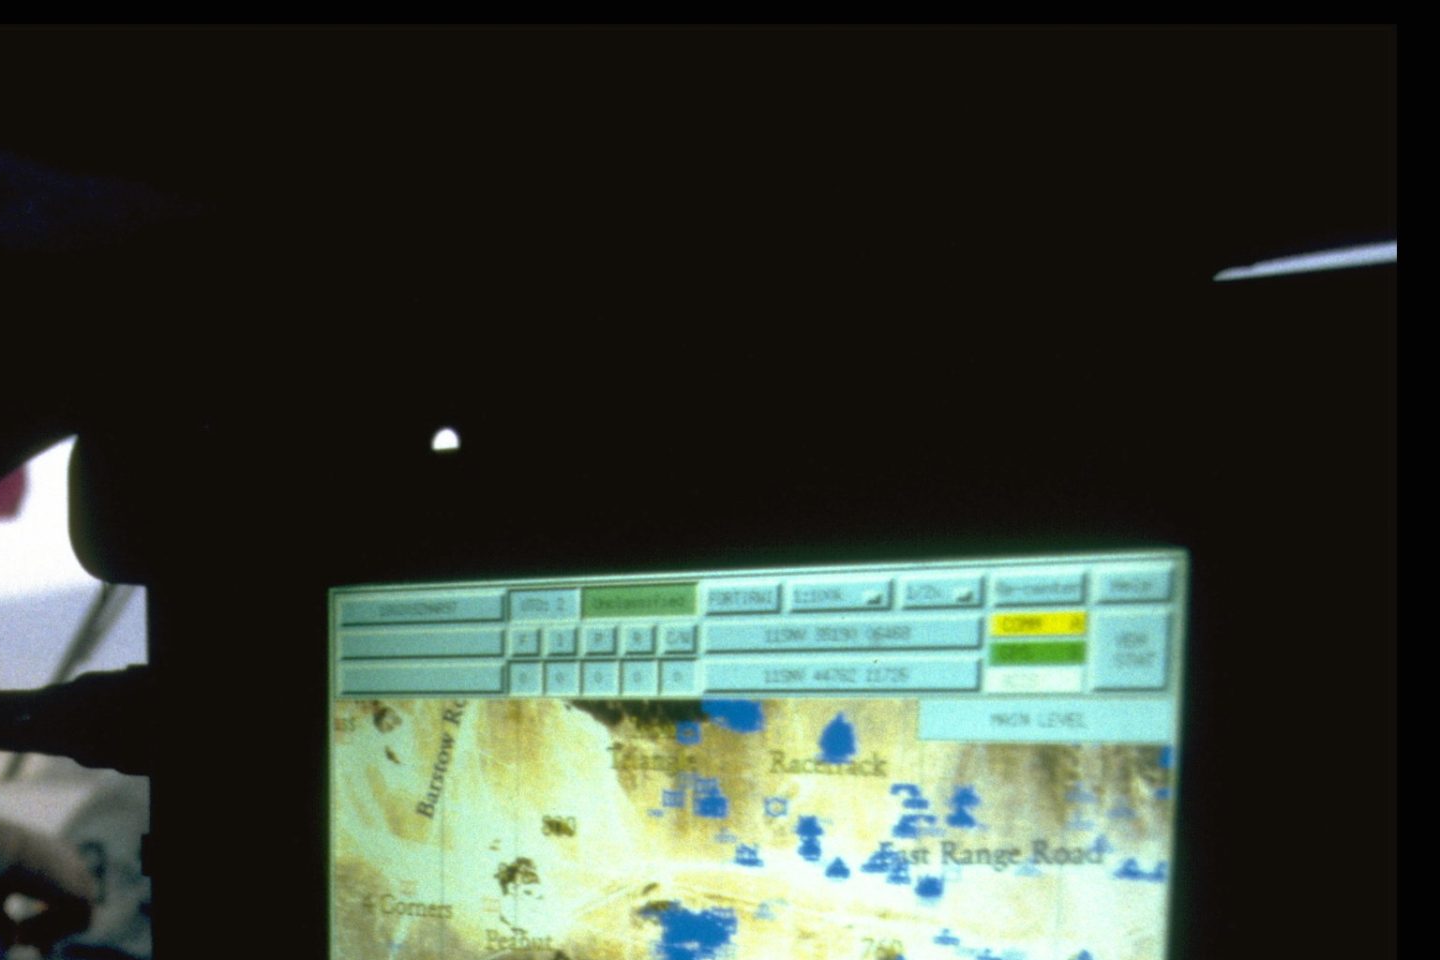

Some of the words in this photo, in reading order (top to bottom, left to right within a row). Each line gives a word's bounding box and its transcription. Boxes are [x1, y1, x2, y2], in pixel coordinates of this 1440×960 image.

[416, 732, 455, 819] Barstow
[940, 843, 1021, 873] Range
[1029, 840, 1105, 866] Road
[380, 893, 453, 919] Corners
